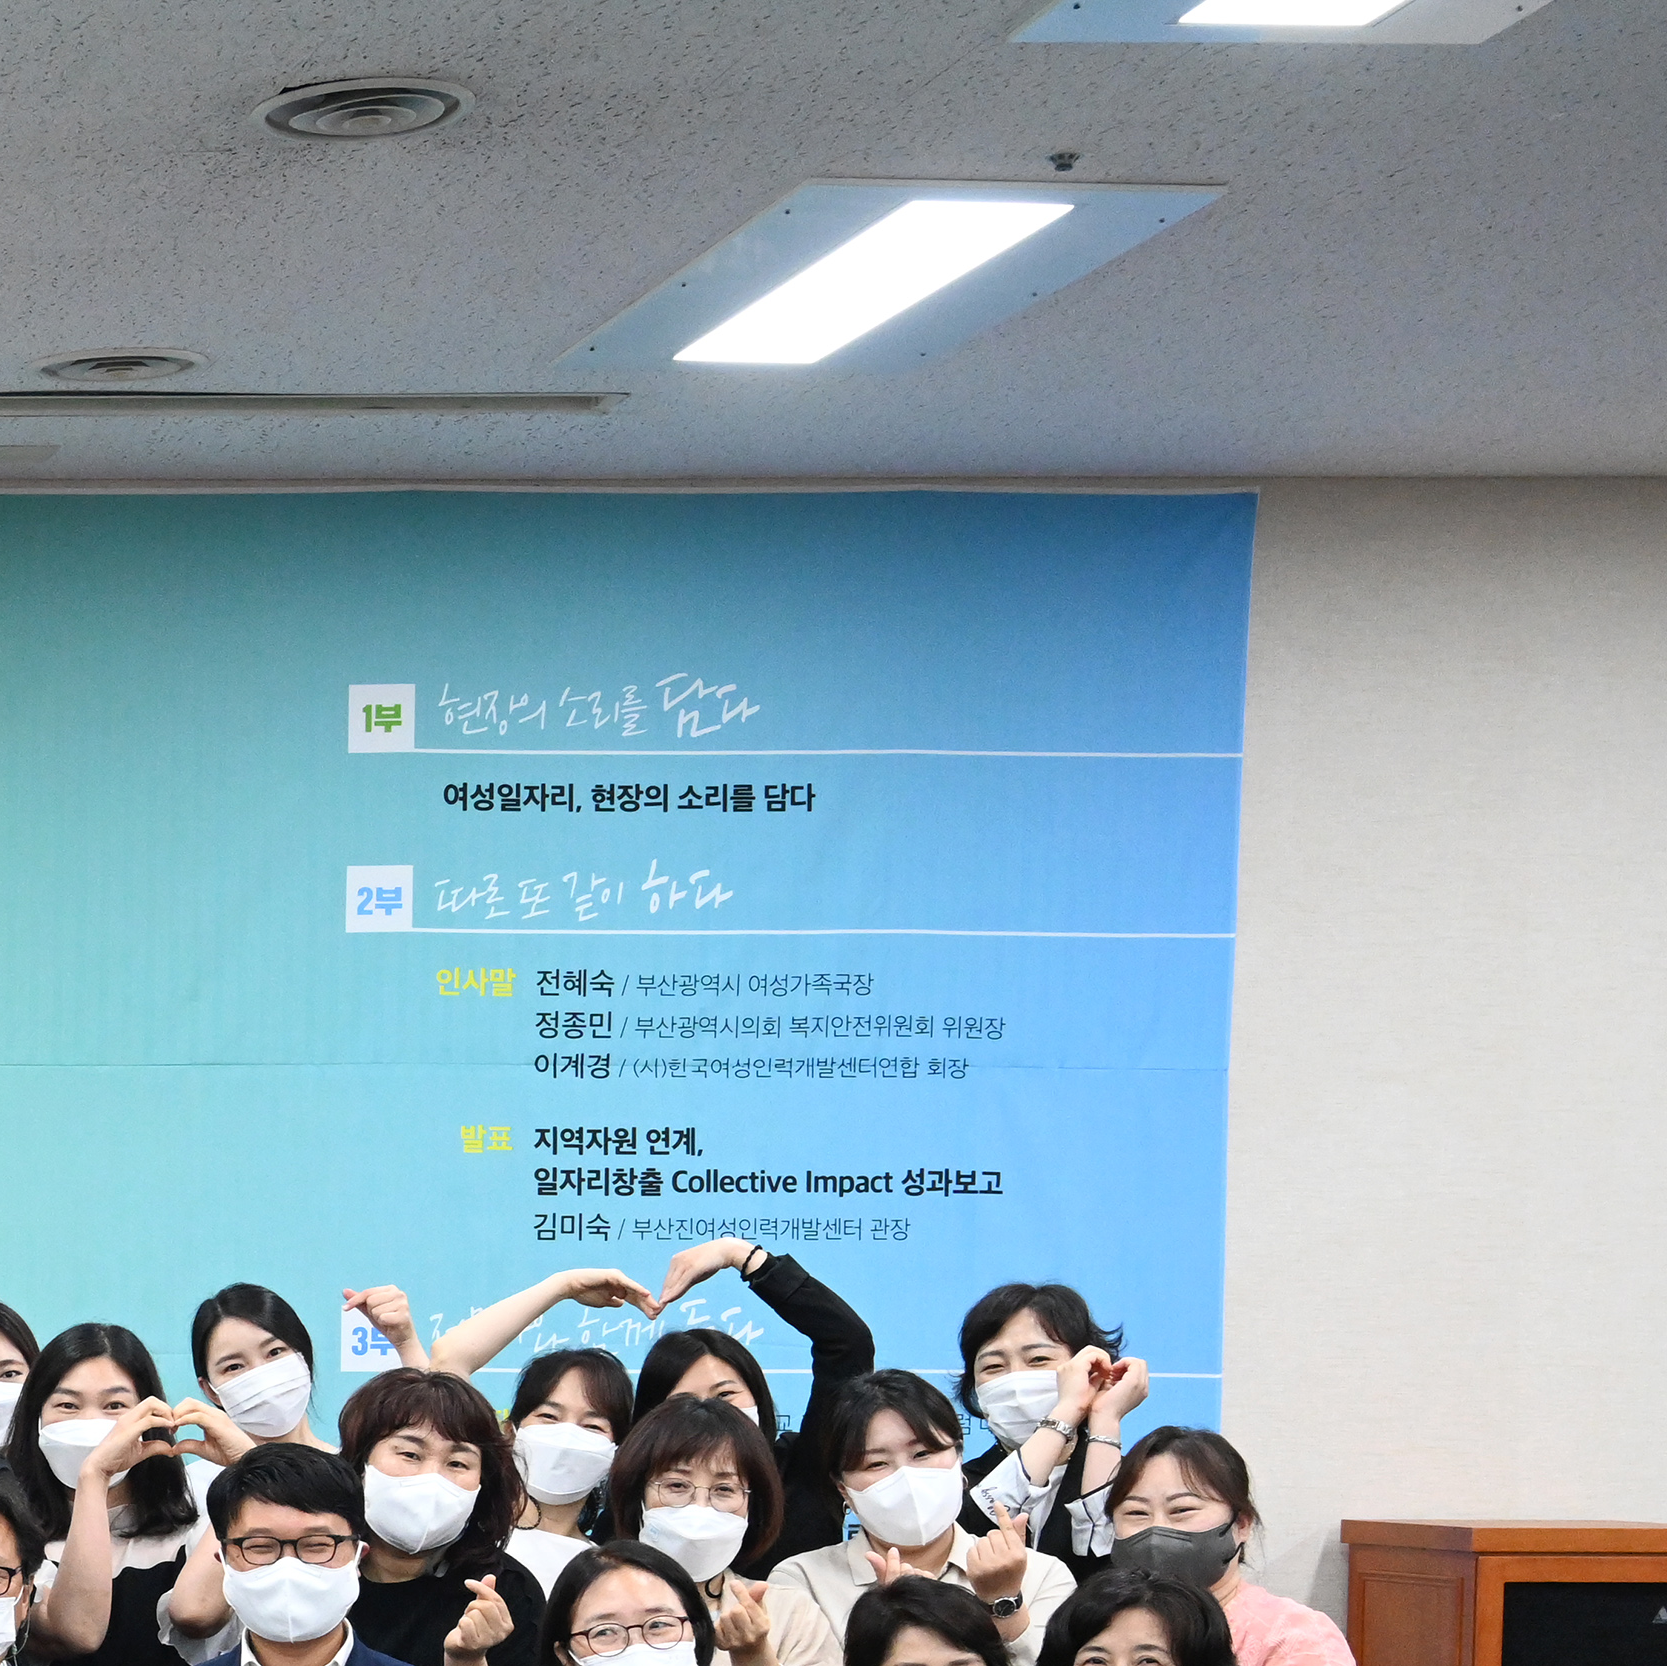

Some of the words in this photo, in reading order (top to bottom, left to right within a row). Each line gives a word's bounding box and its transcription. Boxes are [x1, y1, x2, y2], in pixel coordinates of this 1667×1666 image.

[362, 703, 403, 733] 1부
[438, 683, 547, 736] 현장의
[558, 685, 649, 737] 소리를
[655, 672, 761, 738] 담다
[442, 782, 583, 814] 여성일자리,
[590, 782, 669, 813] 현장의
[676, 783, 756, 813] 소리를
[763, 783, 816, 813] 담다
[356, 885, 403, 917] 2부
[433, 872, 512, 920] 따로
[517, 878, 551, 920] 또
[562, 871, 624, 922] 같이
[640, 857, 734, 915] 하다
[436, 966, 517, 998] 인사말
[535, 968, 615, 998] 전혜숙
[635, 973, 741, 998] 부산광역시
[748, 972, 874, 998] 여성가족국장
[534, 1010, 613, 1040] 정종민
[634, 1015, 782, 1040] 부산광역시의회
[788, 1014, 935, 1039] 복지안전위원회
[941, 1015, 1007, 1041] 위원장
[533, 1052, 611, 1080] 이계경
[927, 1056, 970, 1080] 회장
[460, 1124, 514, 1154] 발표
[533, 1126, 638, 1156] 지역자원
[645, 1126, 704, 1157] 연계,
[533, 1166, 664, 1197] 일자리창출
[671, 1168, 798, 1194] Collective
[805, 1169, 894, 1198] Impact
[901, 1167, 1004, 1197] 성과보고
[533, 1212, 611, 1242] 김미숙
[631, 1217, 863, 1242] 부산진여성인력개발센터
[870, 1217, 911, 1242] 관장
